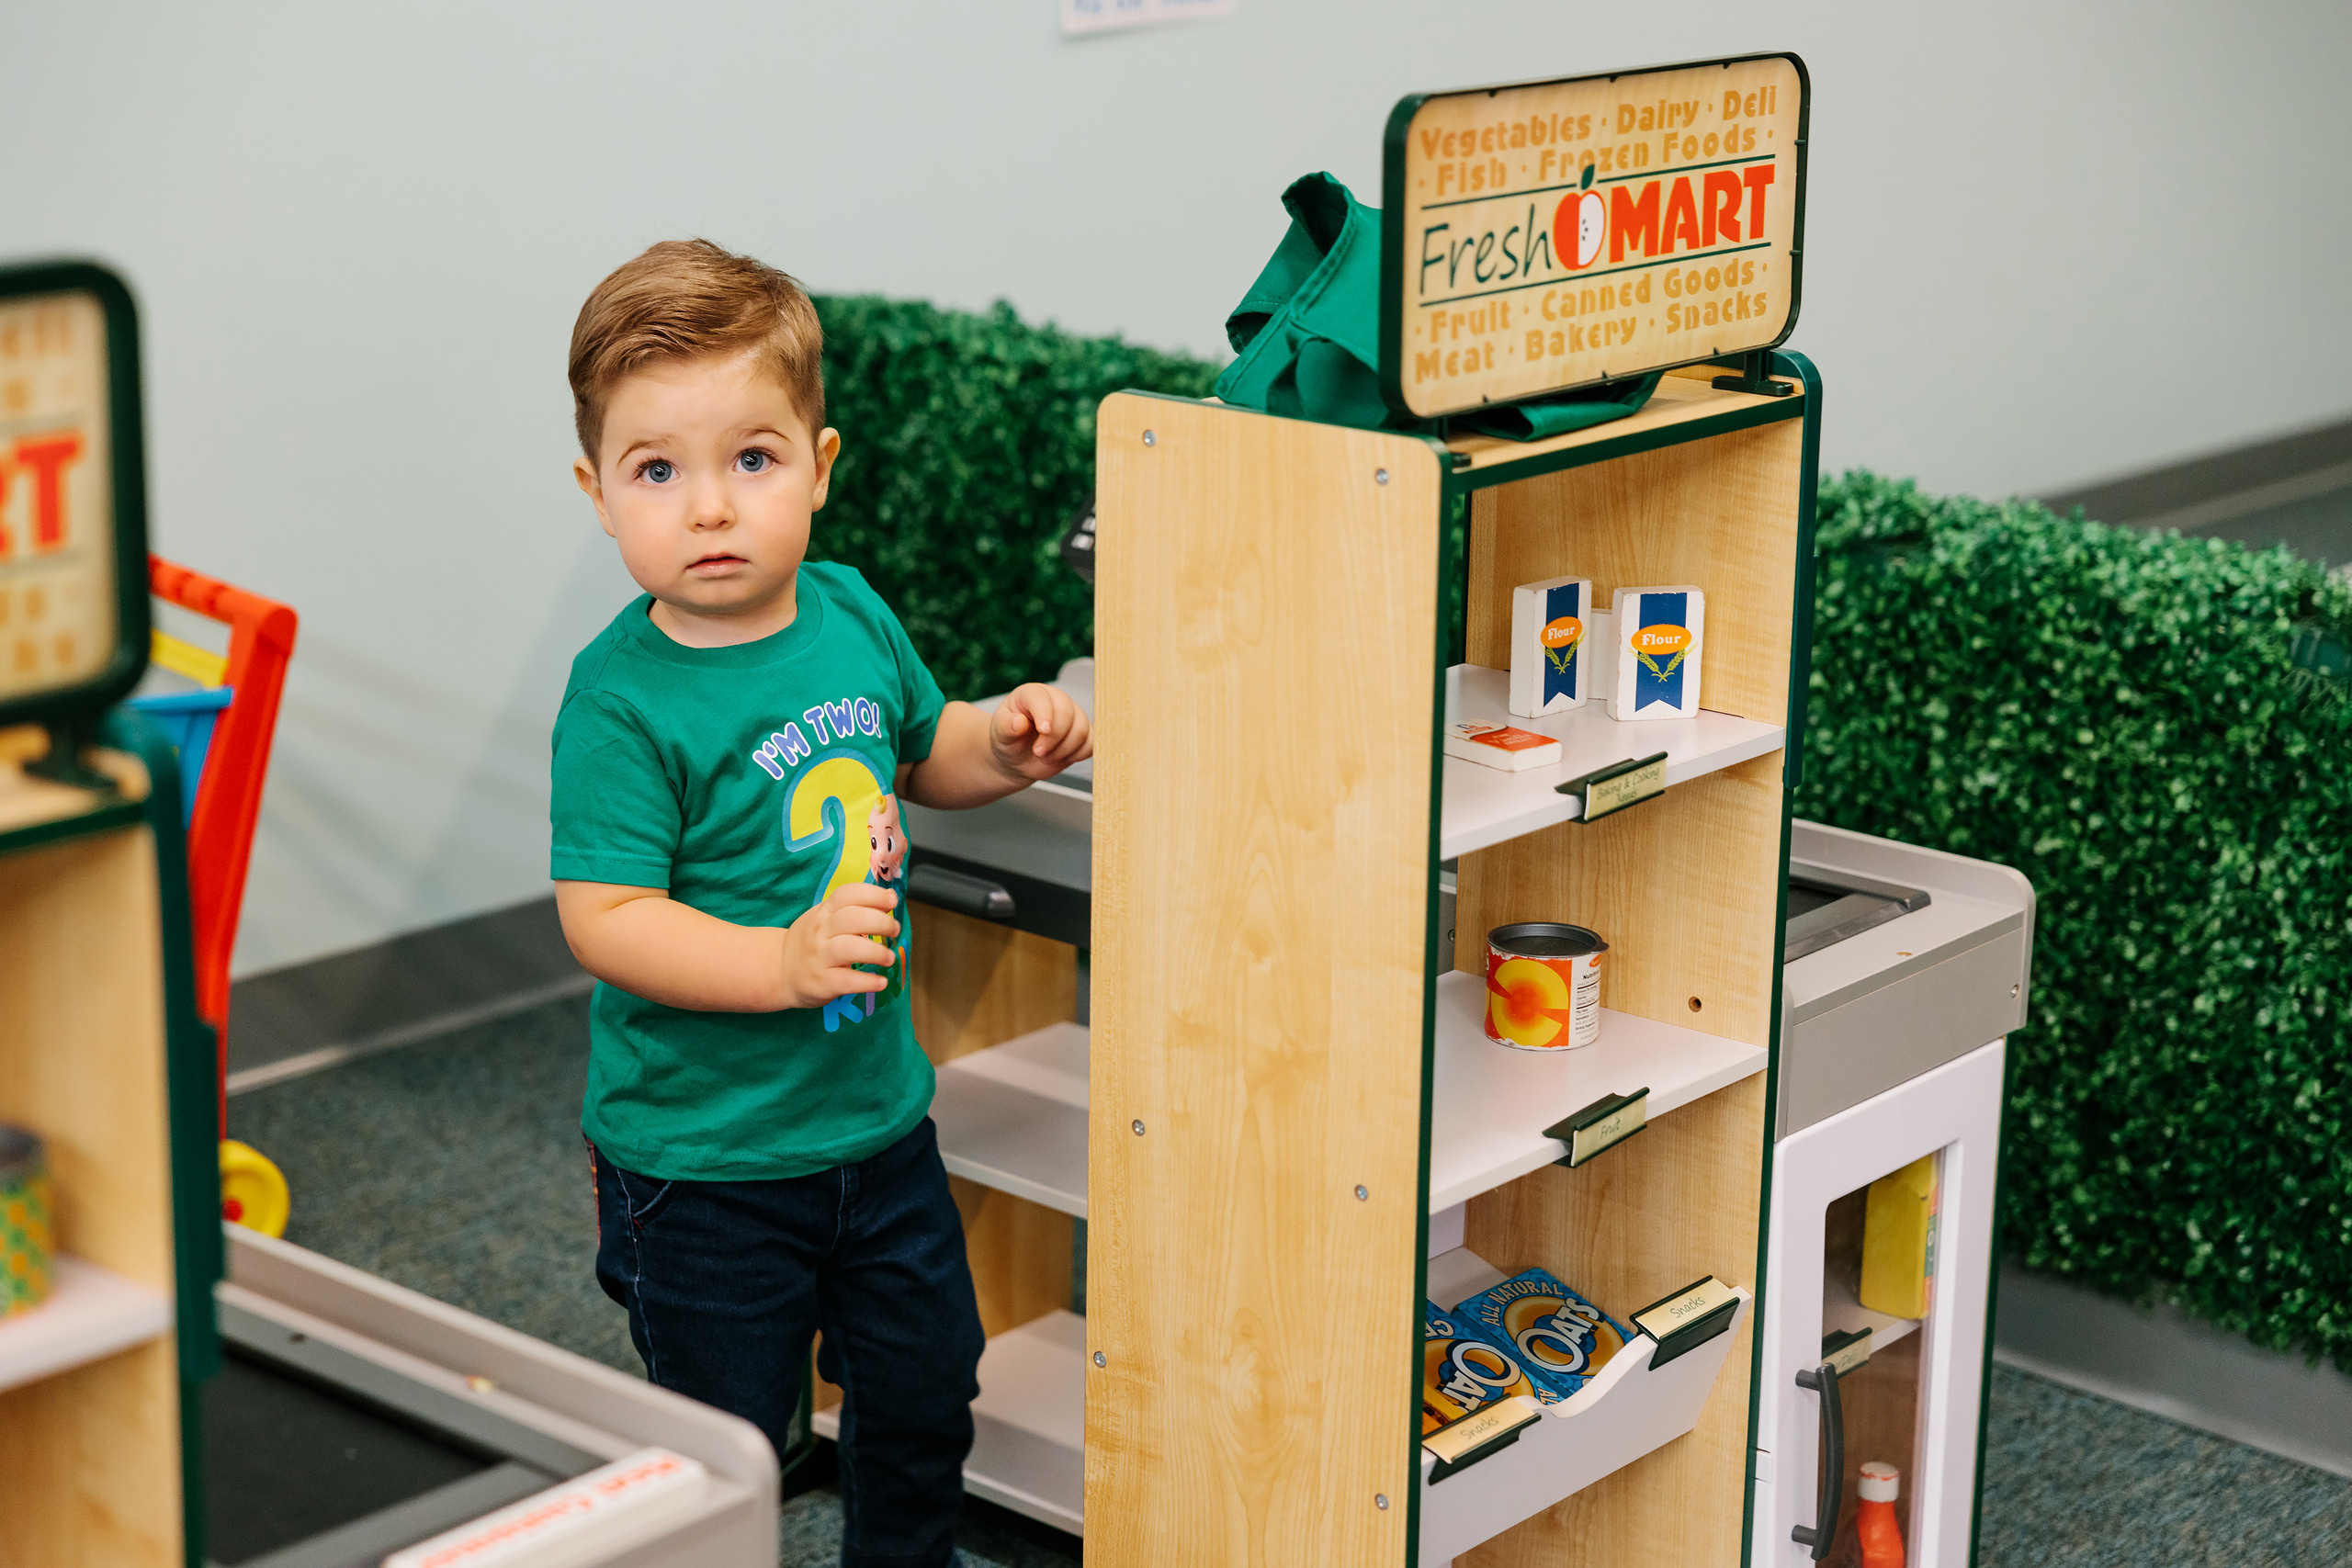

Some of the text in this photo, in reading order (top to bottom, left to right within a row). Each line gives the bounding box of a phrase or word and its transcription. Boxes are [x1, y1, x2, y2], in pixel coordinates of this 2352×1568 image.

[1420, 85, 1777, 160] Vegetables Dairy Deli
[1436, 124, 1756, 197] Fish Frozen Foods
[1420, 164, 1775, 295] Fresh MART
[1430, 259, 1755, 343] Fruit Canned Goods
[1415, 291, 1767, 384] Meat Bakery Snacks
[1547, 625, 1576, 641] Flour
[1641, 632, 1681, 646] Flour
[752, 696, 882, 781] I'M TWO!
[1600, 1117, 1621, 1140] Fruit
[1480, 1280, 1564, 1327] ALL NATURAL
[1516, 1297, 1600, 1373] OATS
[1669, 1296, 1706, 1319] Snacks
[1442, 1341, 1522, 1413] OAT
[1460, 1416, 1499, 1440] Snacks
